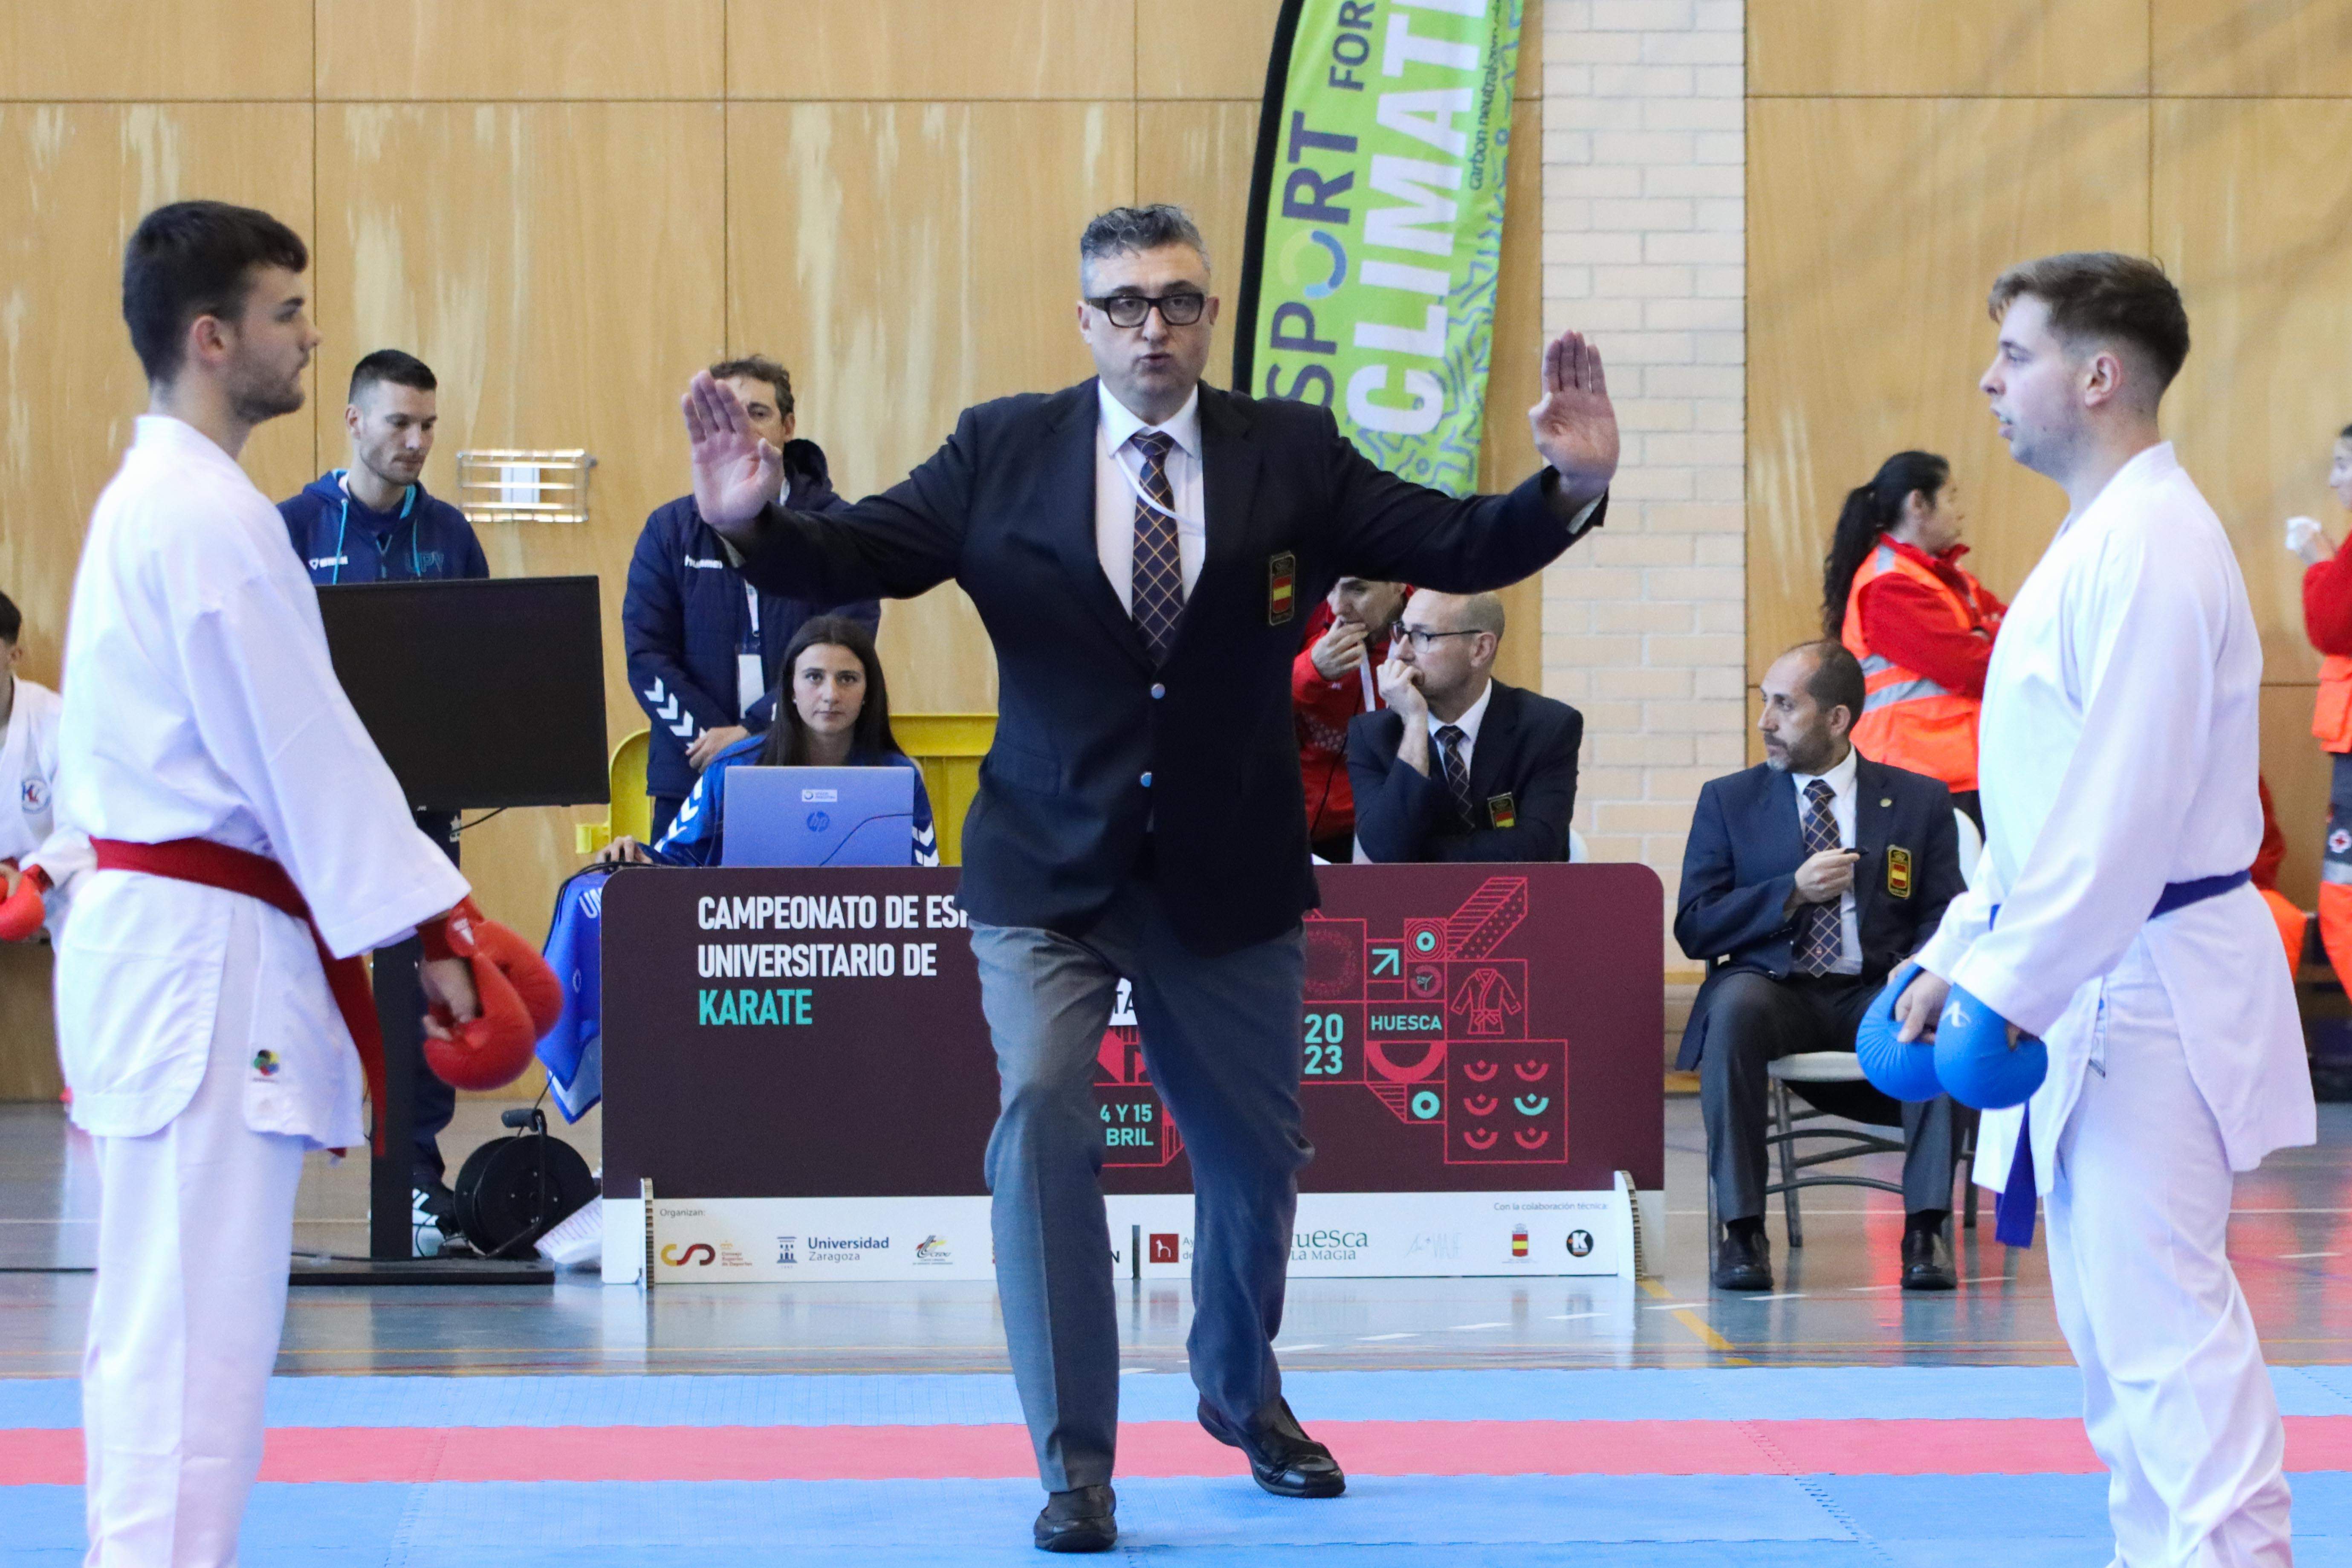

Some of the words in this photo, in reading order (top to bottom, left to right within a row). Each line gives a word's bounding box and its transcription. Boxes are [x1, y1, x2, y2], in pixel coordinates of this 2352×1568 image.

[1468, 130, 1487, 190] carbon
[1266, 110, 1359, 408] SPORT
[1328, 0, 1377, 91] FOR
[698, 896, 877, 930] CAMPEONATO
[885, 895, 919, 929] DE
[698, 943, 895, 978] UNIVERSITARIO
[903, 943, 937, 976] DE
[699, 989, 813, 1025] KARATE
[1304, 1013, 1344, 1044] 20
[1371, 1015, 1442, 1031] HUESCA
[1304, 1044, 1343, 1075] 23
[1099, 1104, 1111, 1123] 4
[1115, 1104, 1129, 1122] Y
[1133, 1103, 1153, 1122] 15
[1106, 1128, 1154, 1146] BRIL
[660, 1208, 706, 1218] Organizan:
[1494, 1203, 1510, 1211] Con
[1513, 1202, 1520, 1210] la
[1522, 1202, 1575, 1211] colaboración
[808, 1237, 889, 1249] Universidad
[1292, 1230, 1369, 1248] uesca
[809, 1251, 860, 1263] Zaragoza
